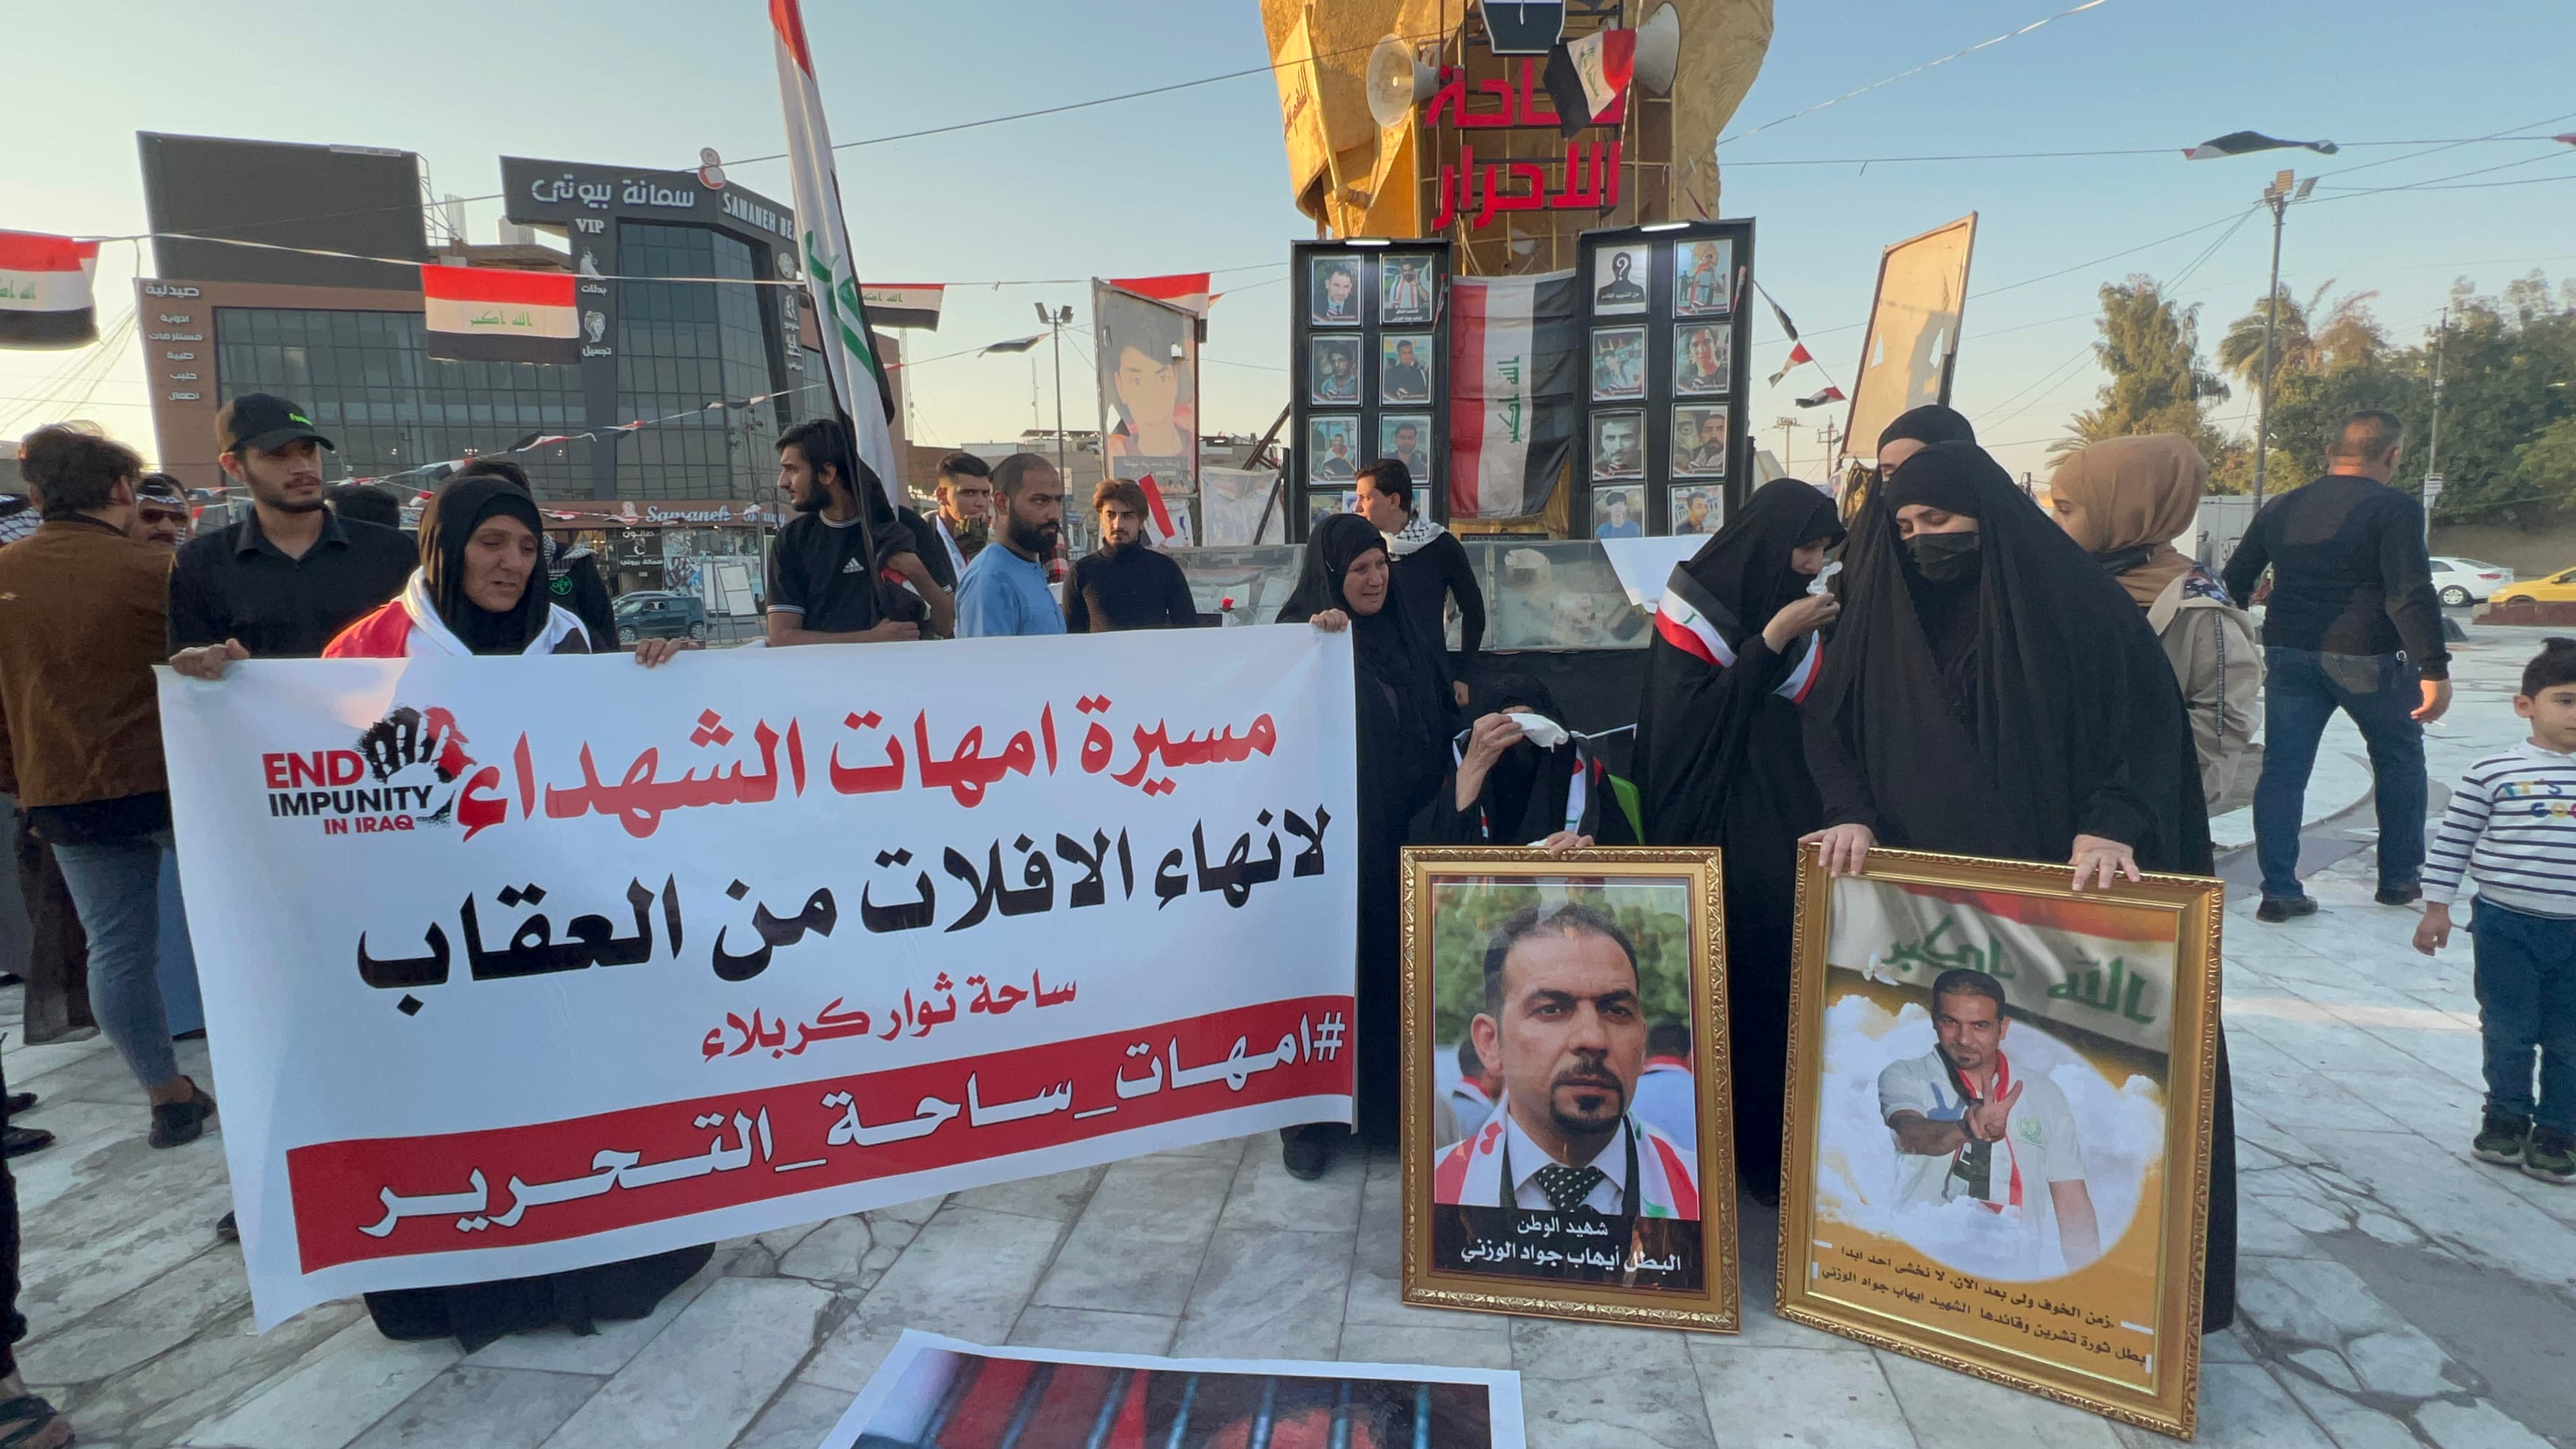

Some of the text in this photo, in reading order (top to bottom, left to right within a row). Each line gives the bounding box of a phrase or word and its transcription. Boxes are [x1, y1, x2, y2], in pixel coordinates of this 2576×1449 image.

[623, 179, 694, 208] سمانة
[1431, 141, 1622, 231] الاحرار
[575, 218, 605, 234] VIP
[722, 192, 795, 242] SAMANEH BE
[146, 284, 200, 298] صيدلية
[581, 285, 607, 295] بدلات
[512, 311, 533, 327] الله
[583, 345, 612, 357] تجميل
[645, 505, 732, 523] Samaneh
[262, 749, 364, 789] END
[457, 693, 1277, 842] مسيرة امهات الشهداء
[268, 785, 433, 817] IMPUNITY
[324, 813, 415, 835] IN IRAQ
[358, 803, 1331, 1016] لانهاء الافلات من العقاب
[2049, 947, 2157, 1024] الله
[701, 968, 1077, 1063] ساحة ثوار كربلاء
[1517, 1214, 1609, 1238] شهيد الوطن
[1461, 1238, 1681, 1275] البطل أيهاب جواد الوزني
[1841, 1246, 1862, 1262] ابدا
[1868, 1254, 1891, 1267] احد
[1821, 1266, 1857, 1283] الوزني
[1934, 1270, 1945, 1281] لا
[1862, 1278, 1889, 1294] جواد
[1892, 1287, 1924, 1303] ايهاب
[1984, 1286, 2007, 1299] بعد
[1930, 1297, 1970, 1314] الشهيد
[2037, 1299, 2081, 1318] الخوف
[1980, 1308, 2029, 1333] وقائدها
[2034, 1324, 2077, 1344] تشرين
[2081, 1335, 2111, 1354] ثورة
